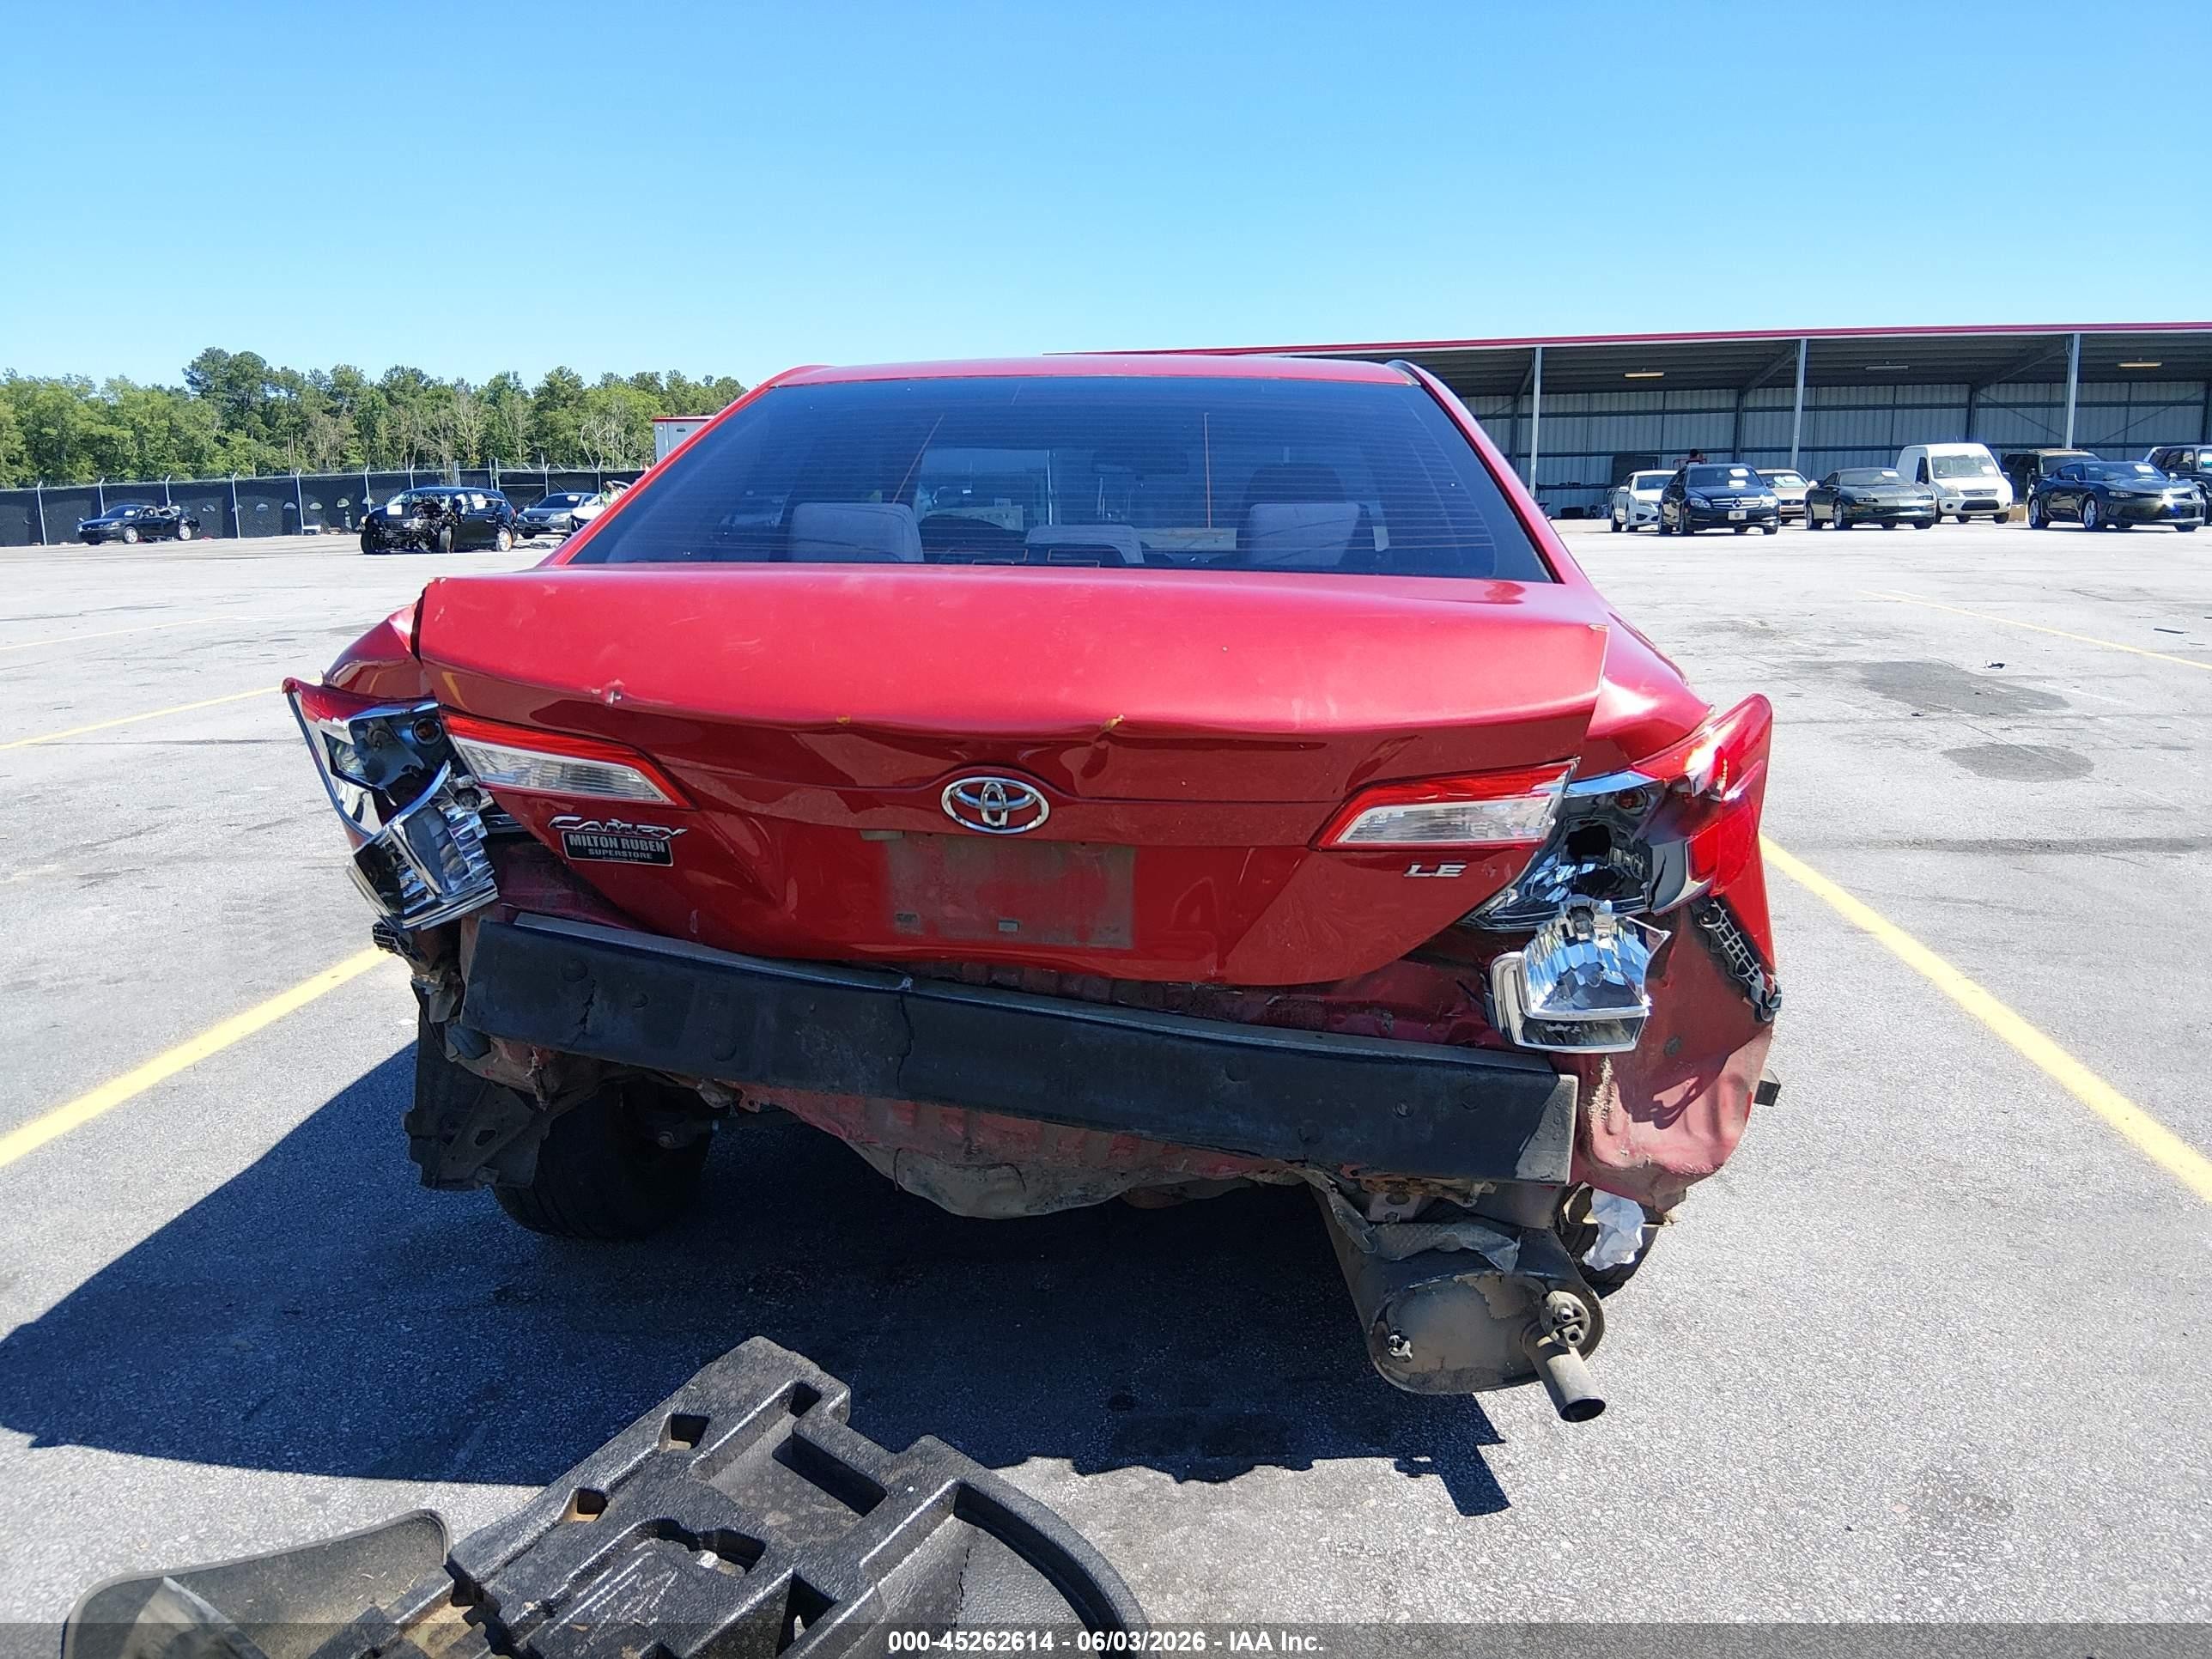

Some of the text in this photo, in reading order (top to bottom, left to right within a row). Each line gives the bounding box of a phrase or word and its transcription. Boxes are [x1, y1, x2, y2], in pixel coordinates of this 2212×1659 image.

[548, 816, 687, 841] CAMRY
[568, 834, 665, 853] MILTON RUBEN
[588, 848, 653, 860] SUPERSTORE
[1403, 864, 1468, 878] LE
